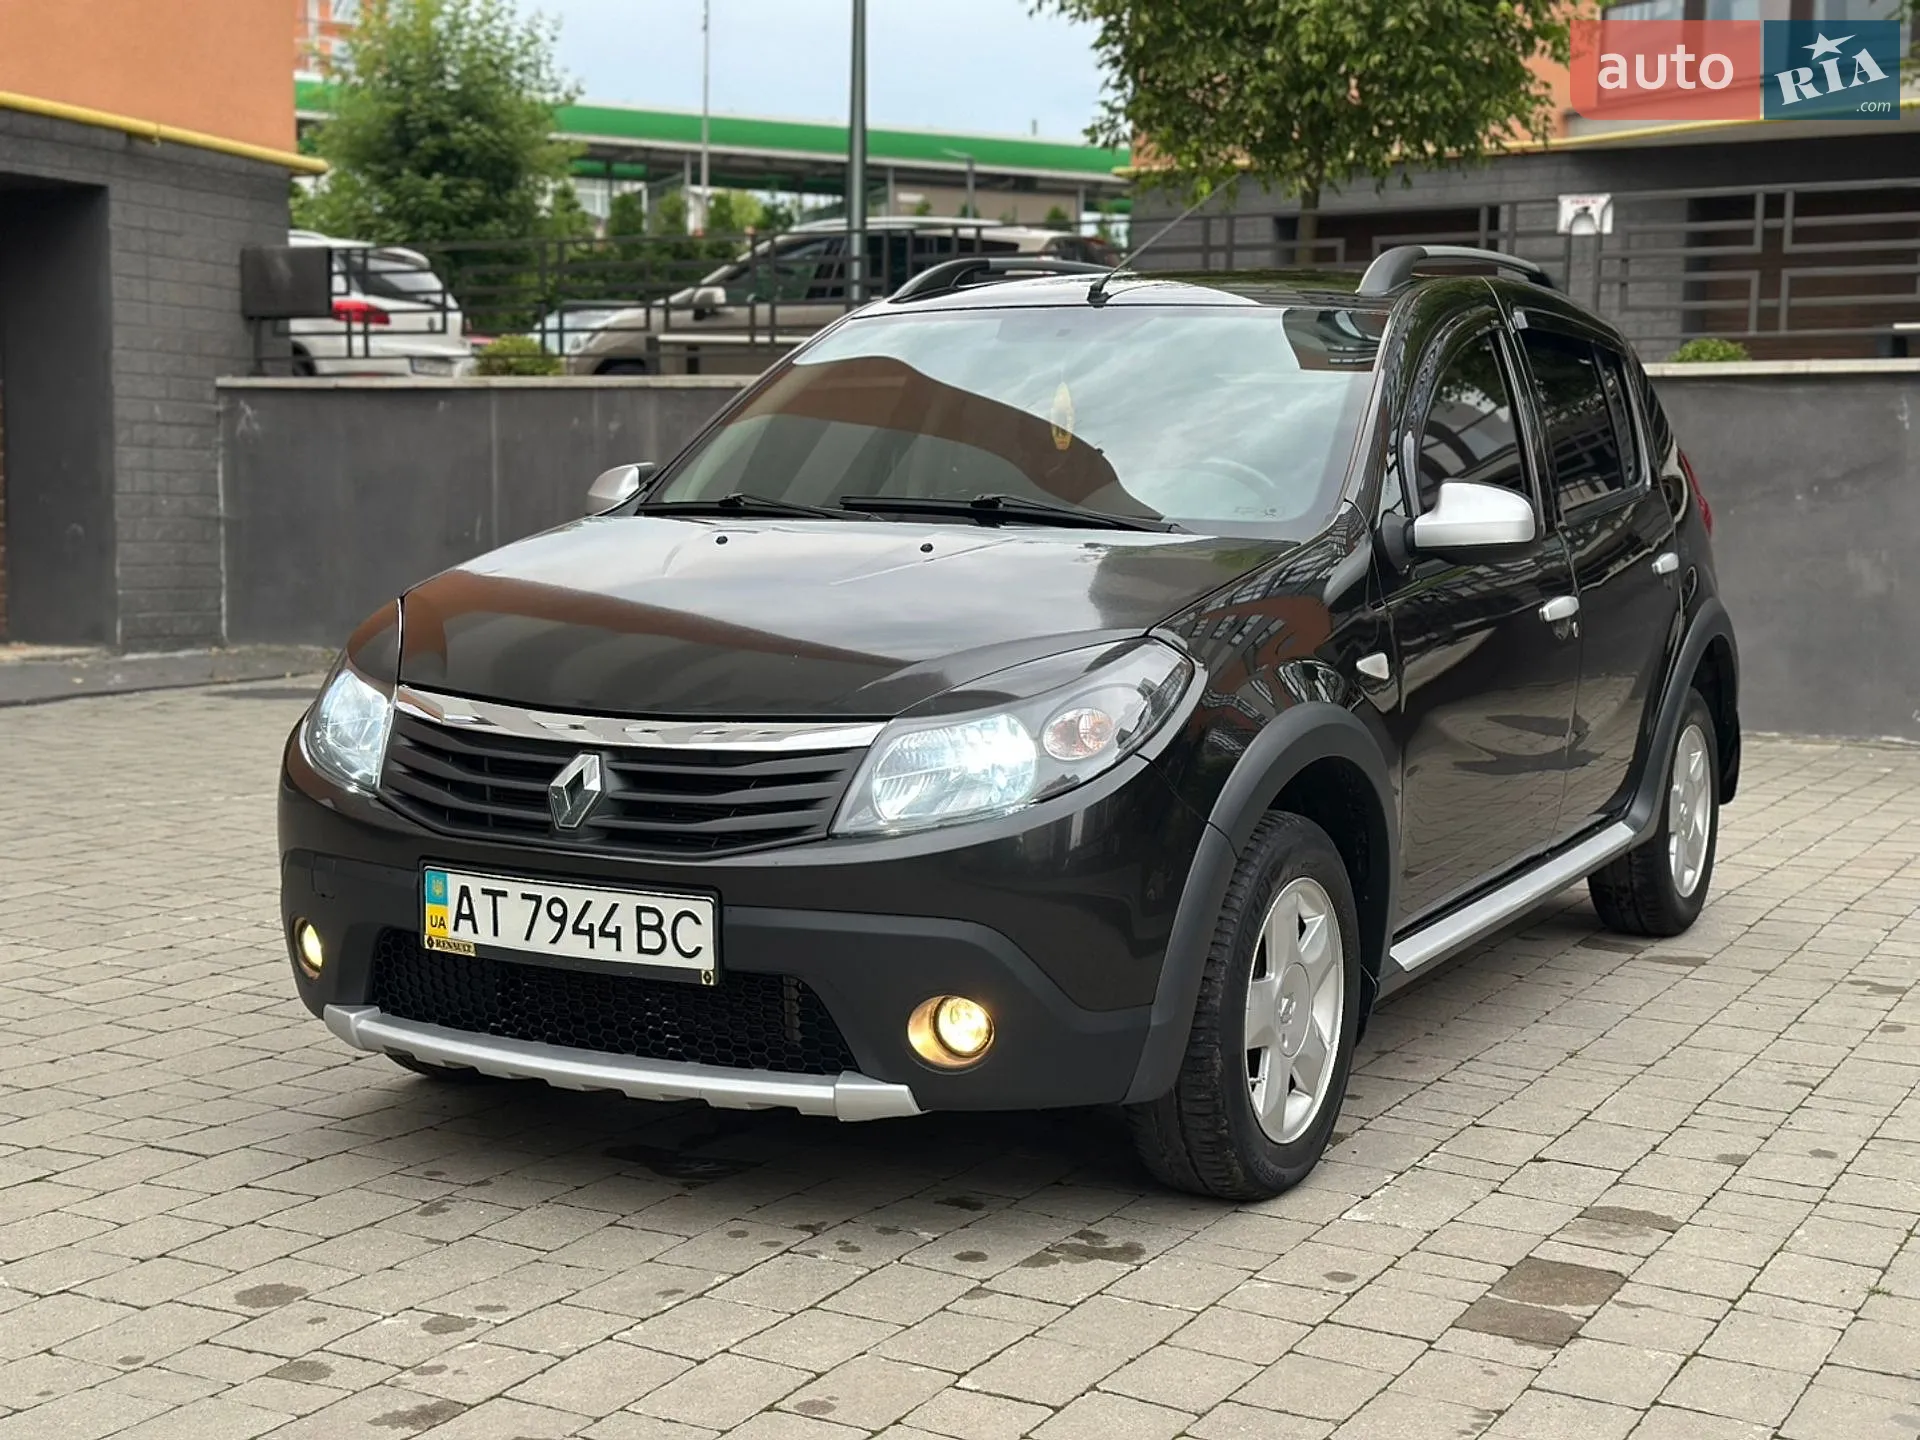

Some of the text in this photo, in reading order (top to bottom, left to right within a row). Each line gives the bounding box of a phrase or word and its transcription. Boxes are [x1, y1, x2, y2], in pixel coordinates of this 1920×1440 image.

[430, 914, 447, 930] UA
[453, 884, 703, 959] AT 7944 BC
